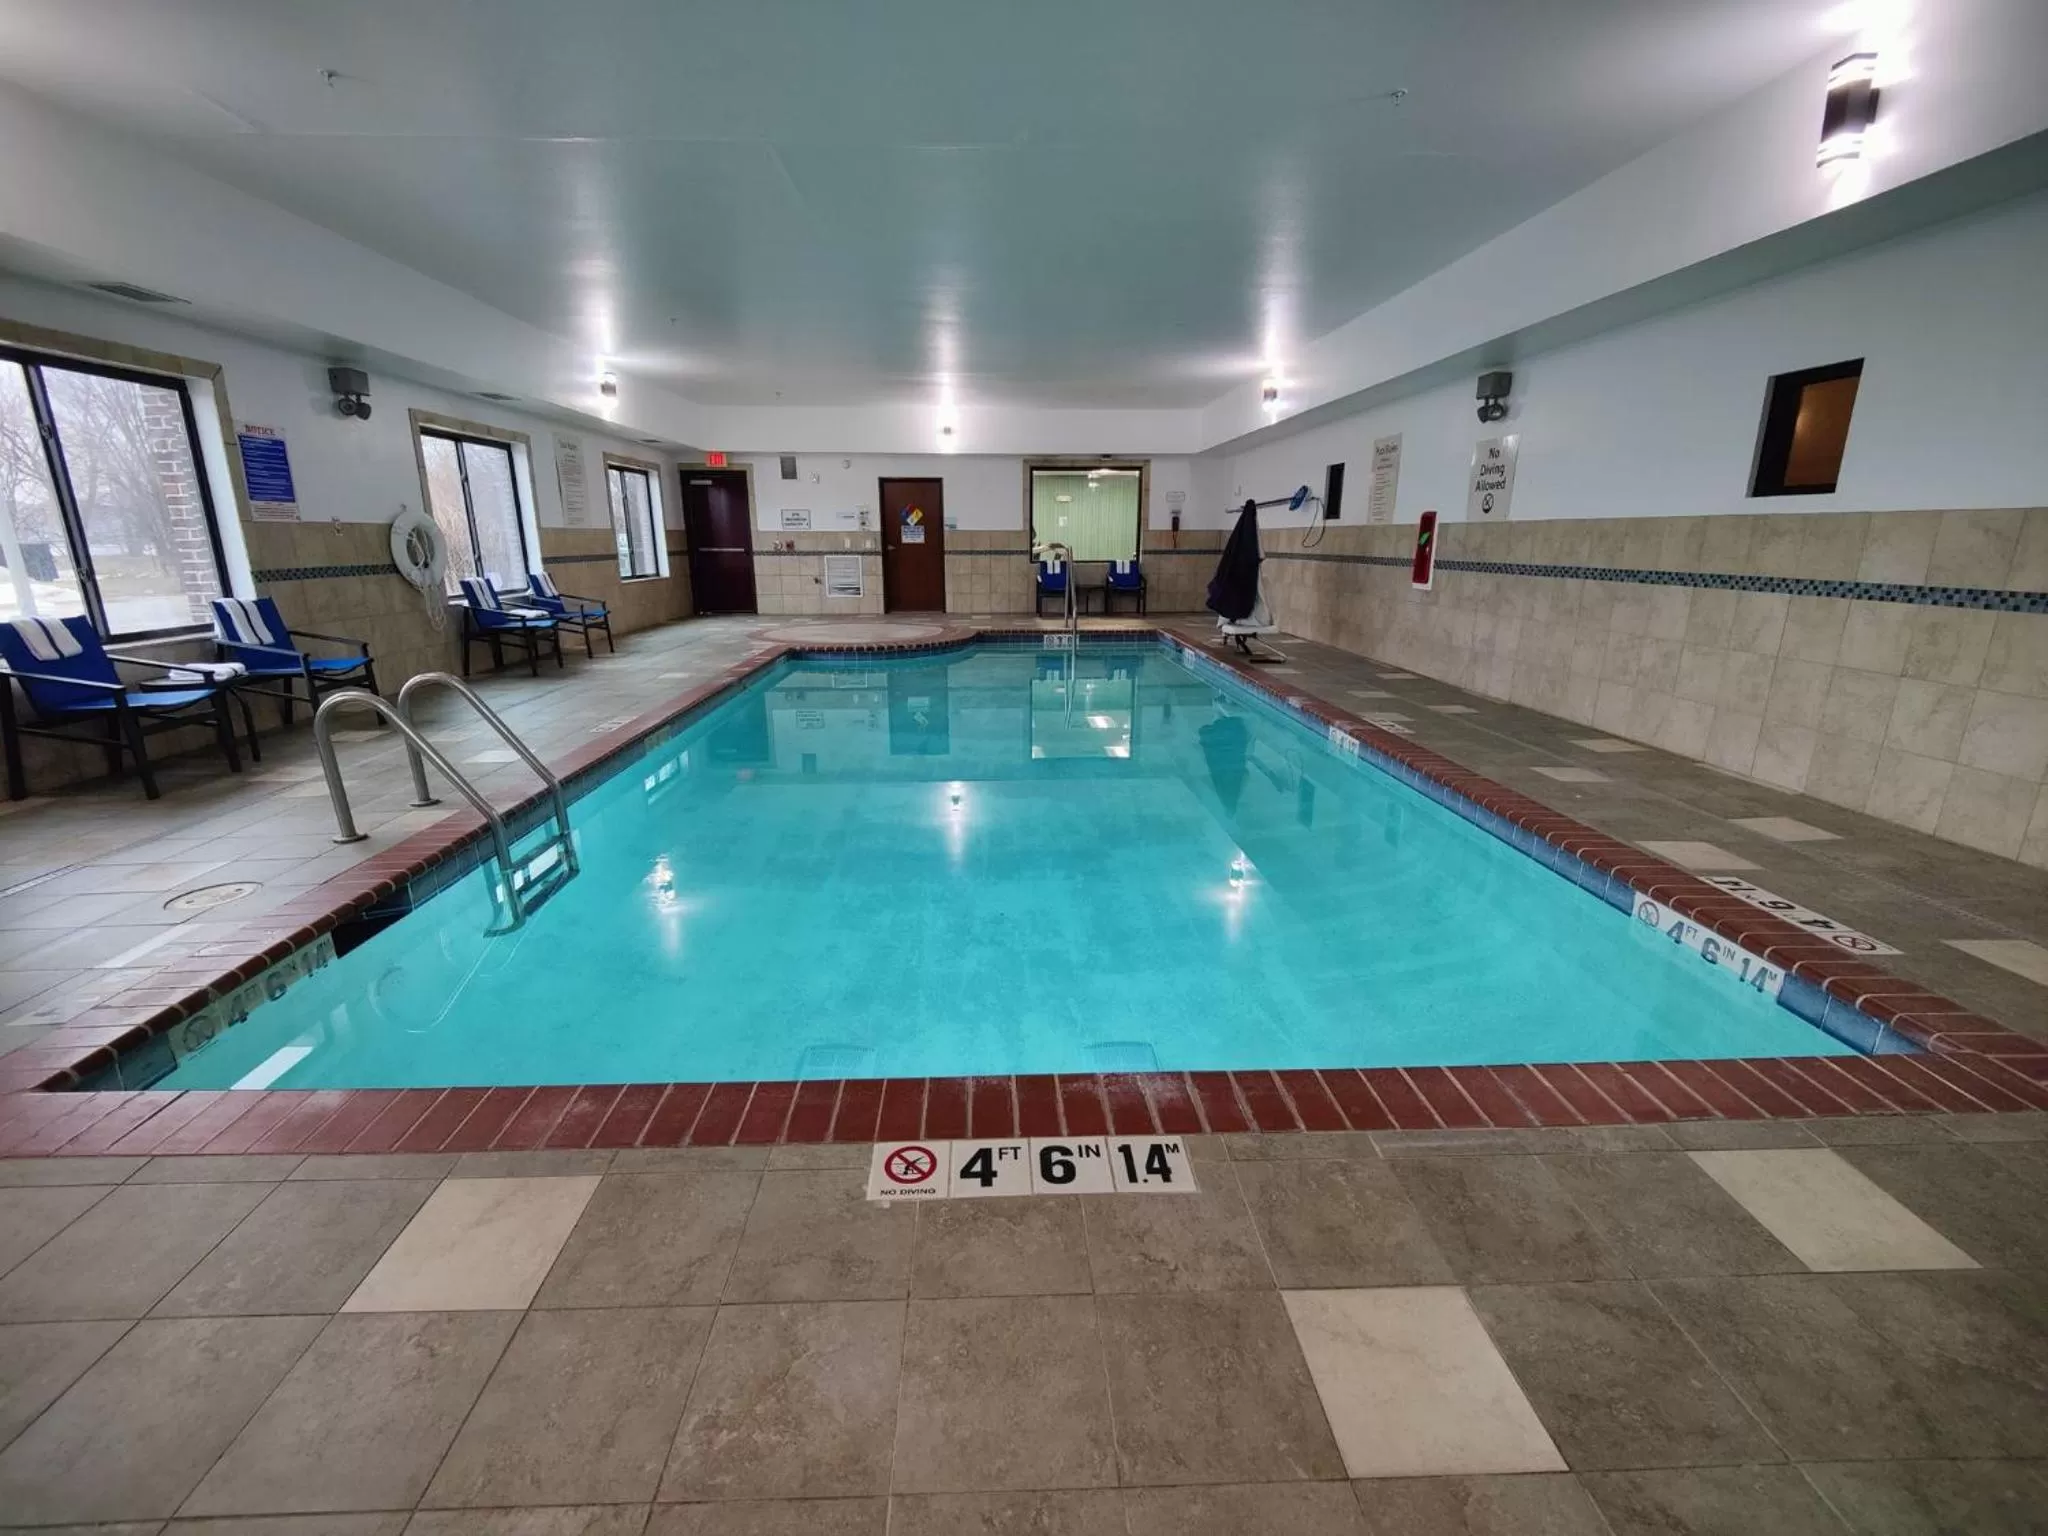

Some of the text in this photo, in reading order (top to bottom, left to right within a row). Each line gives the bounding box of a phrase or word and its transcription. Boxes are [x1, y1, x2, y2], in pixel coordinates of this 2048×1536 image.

[1489, 447, 1500, 459] No
[1480, 463, 1506, 478] Diving
[1475, 477, 1507, 492] Allowed
[899, 1187, 936, 1196] DIVING
